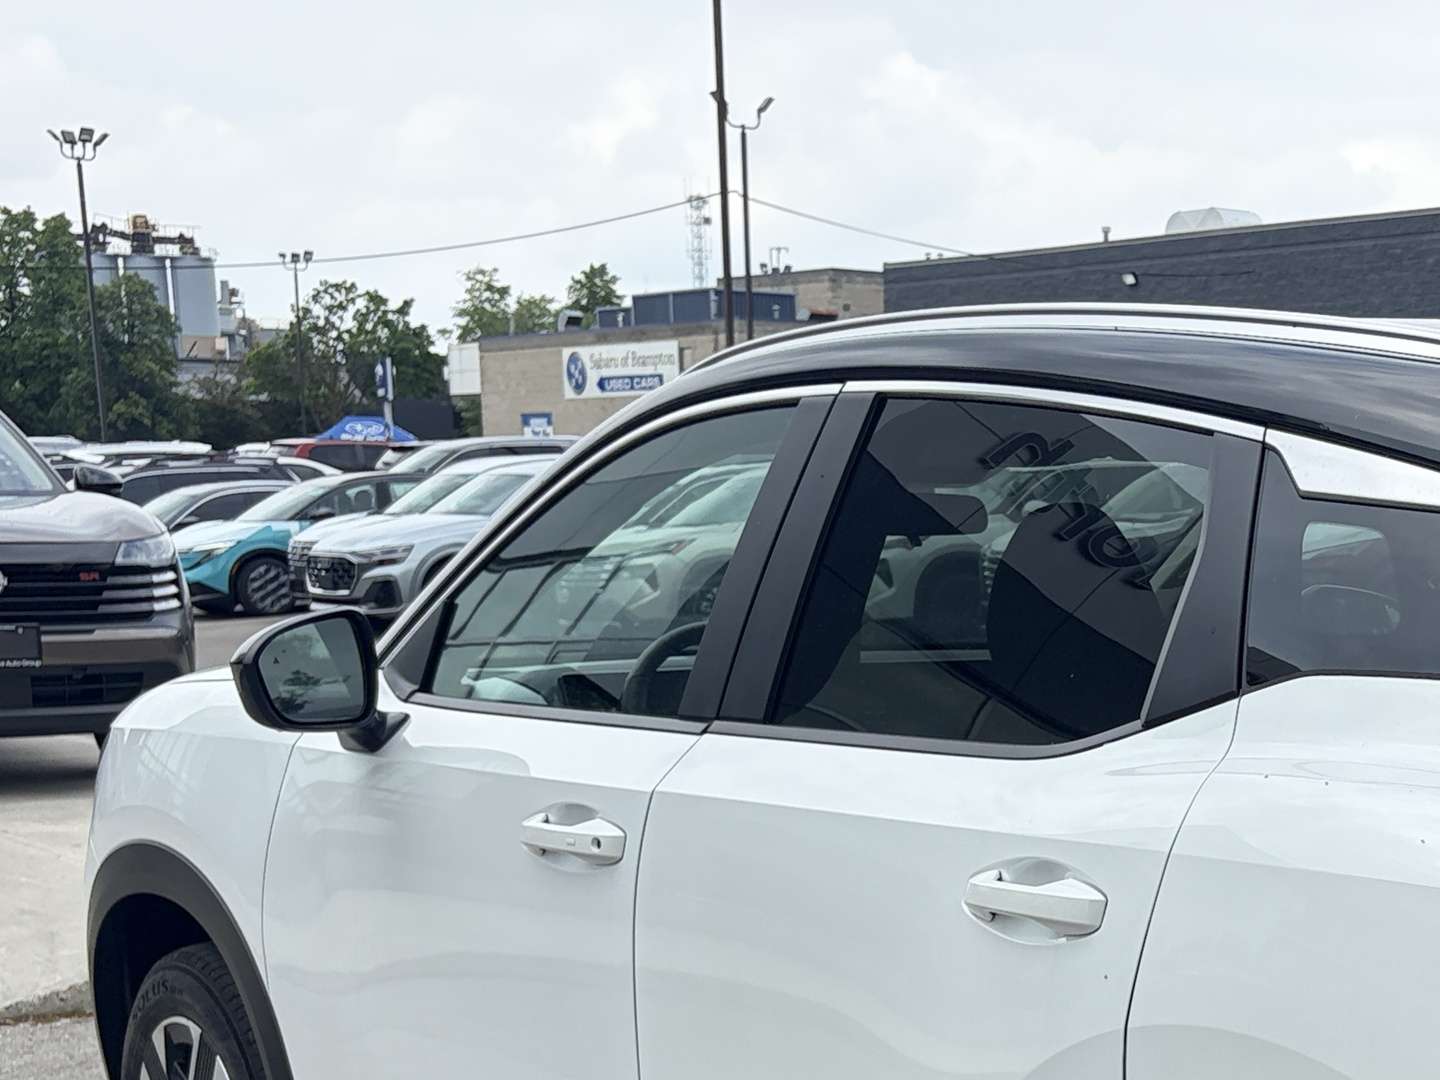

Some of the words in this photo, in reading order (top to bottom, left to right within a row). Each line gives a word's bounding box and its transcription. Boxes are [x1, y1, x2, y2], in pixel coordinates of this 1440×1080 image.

[620, 350, 630, 368] of
[631, 350, 675, 371] Brampton
[604, 378, 631, 391] USED
